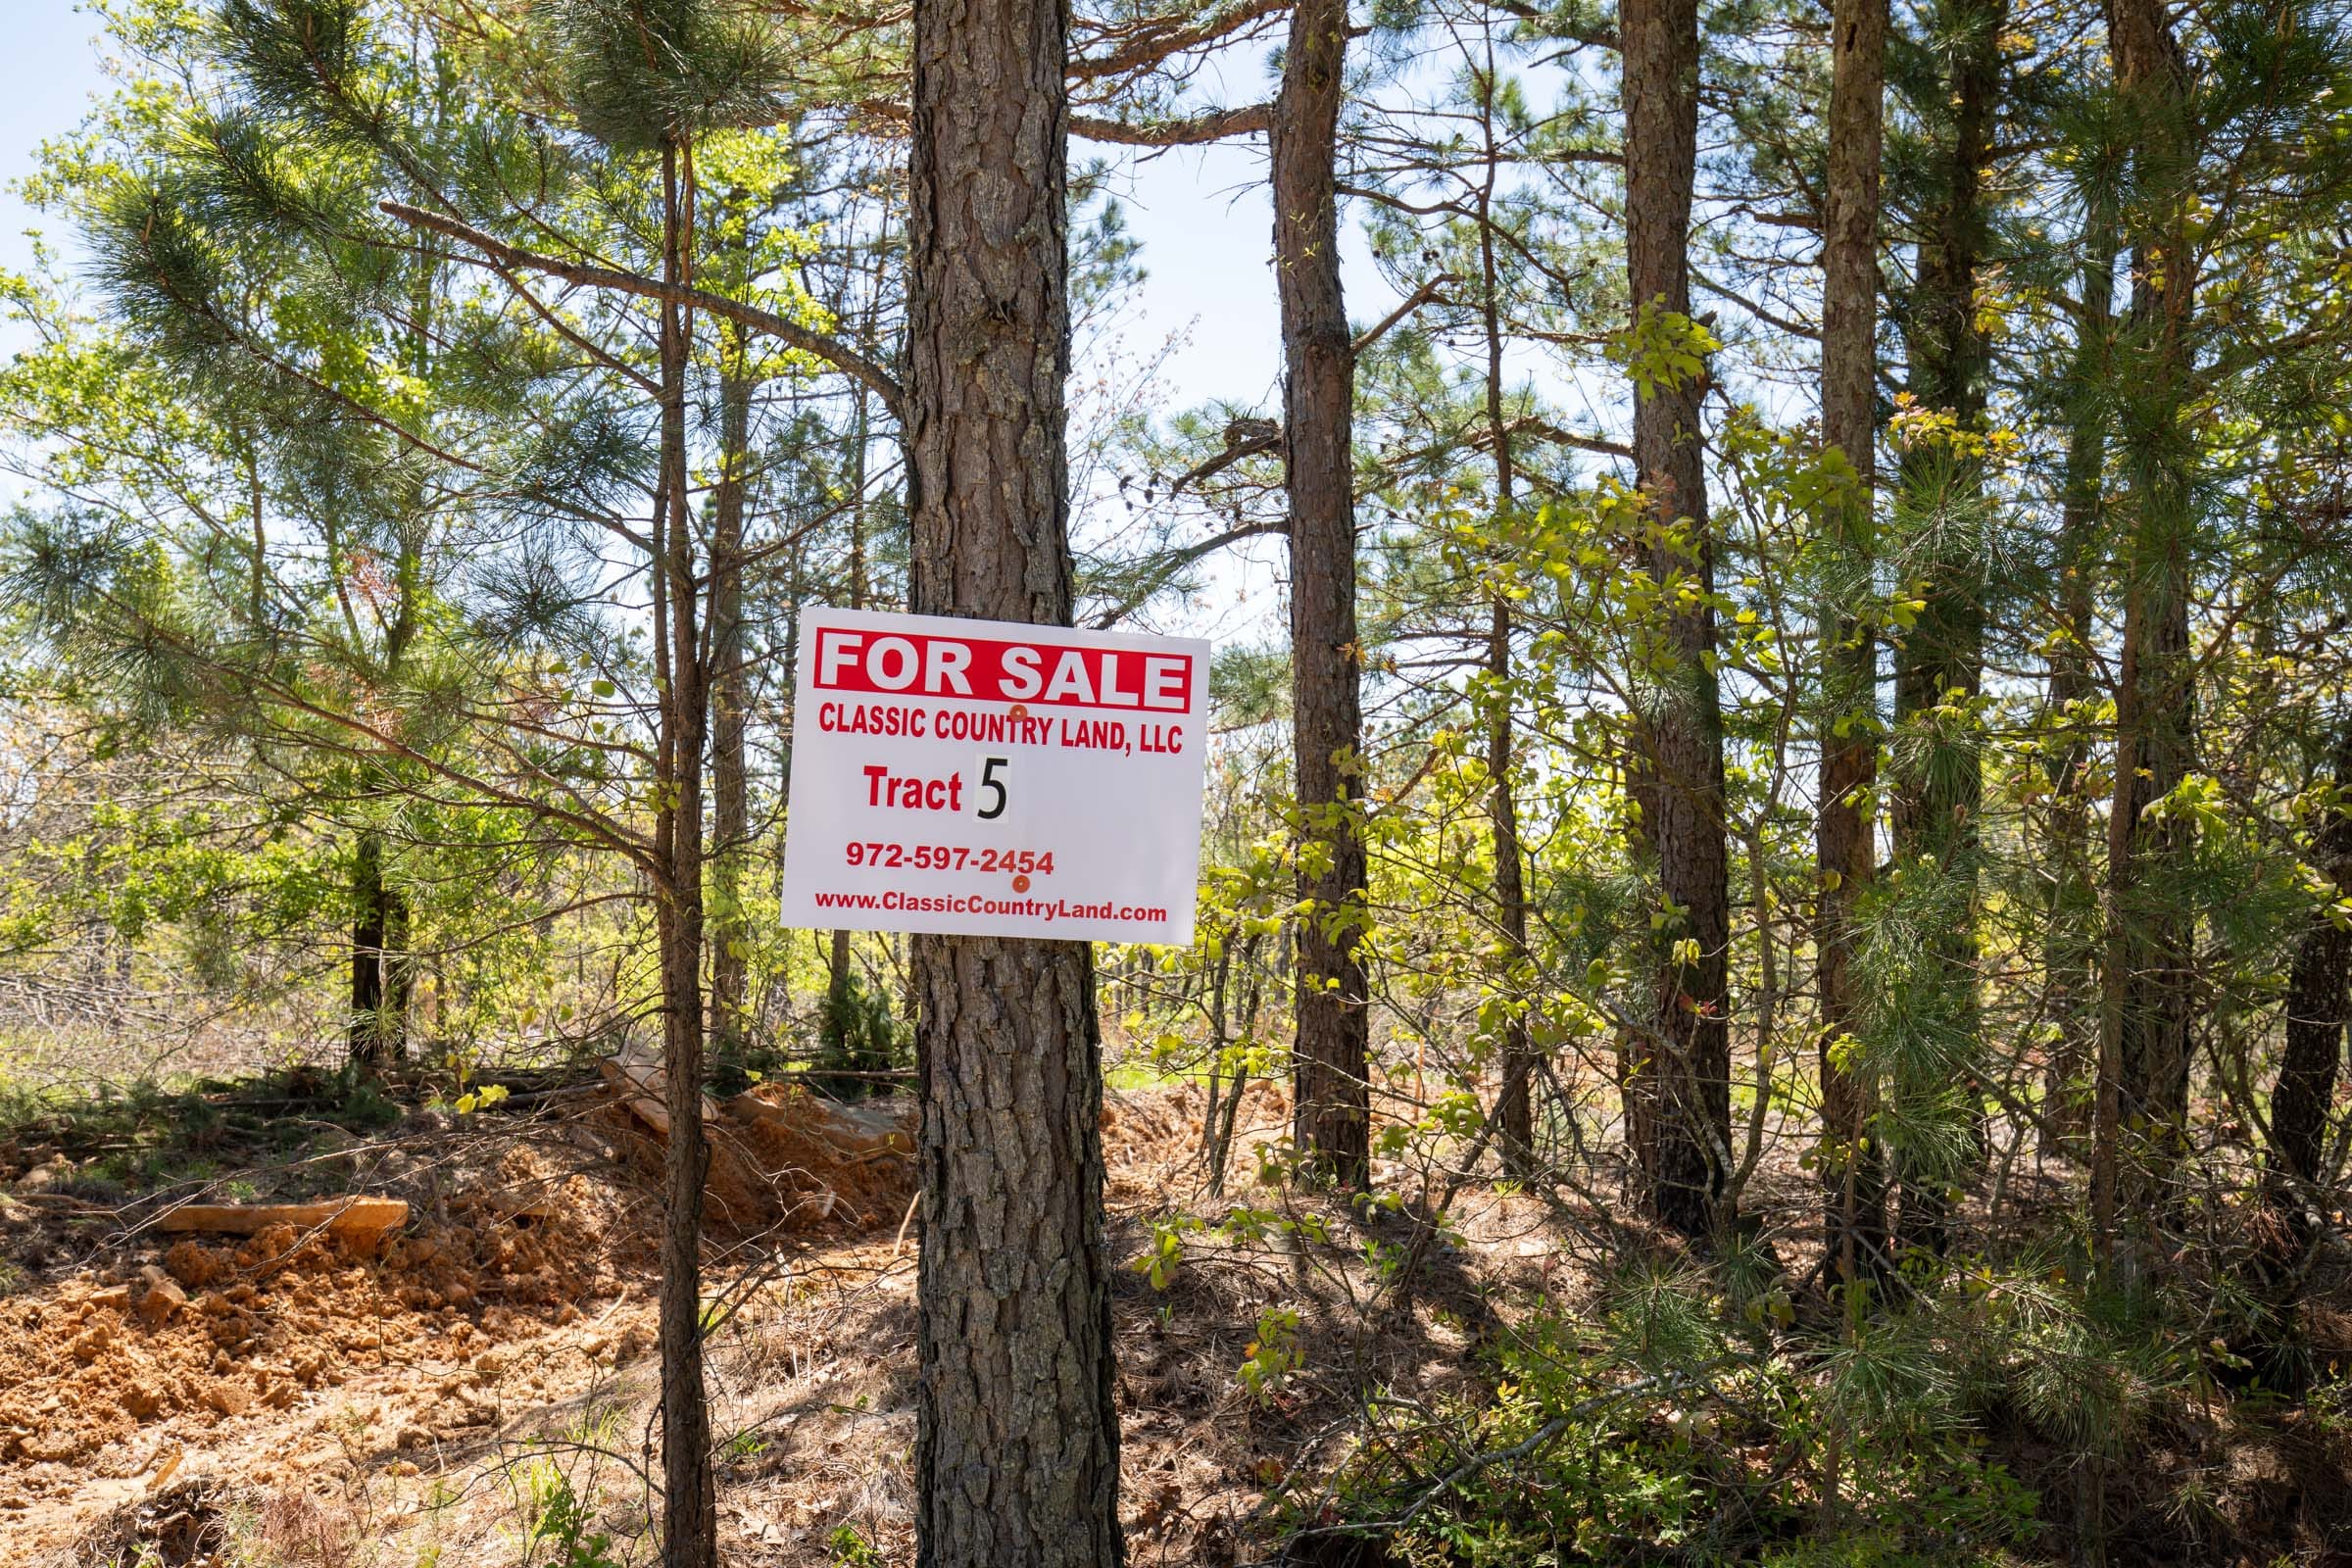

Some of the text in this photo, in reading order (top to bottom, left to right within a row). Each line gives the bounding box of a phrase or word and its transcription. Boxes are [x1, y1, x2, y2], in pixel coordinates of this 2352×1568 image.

[819, 632, 1186, 710] FOR SALE
[818, 702, 1184, 758] CLASSIC COUNTRY LAND, LLC
[863, 758, 1008, 820] Tract 5
[846, 841, 1054, 875] 972-597-2454
[814, 890, 1167, 922] www.ClassicCountryLand.com
